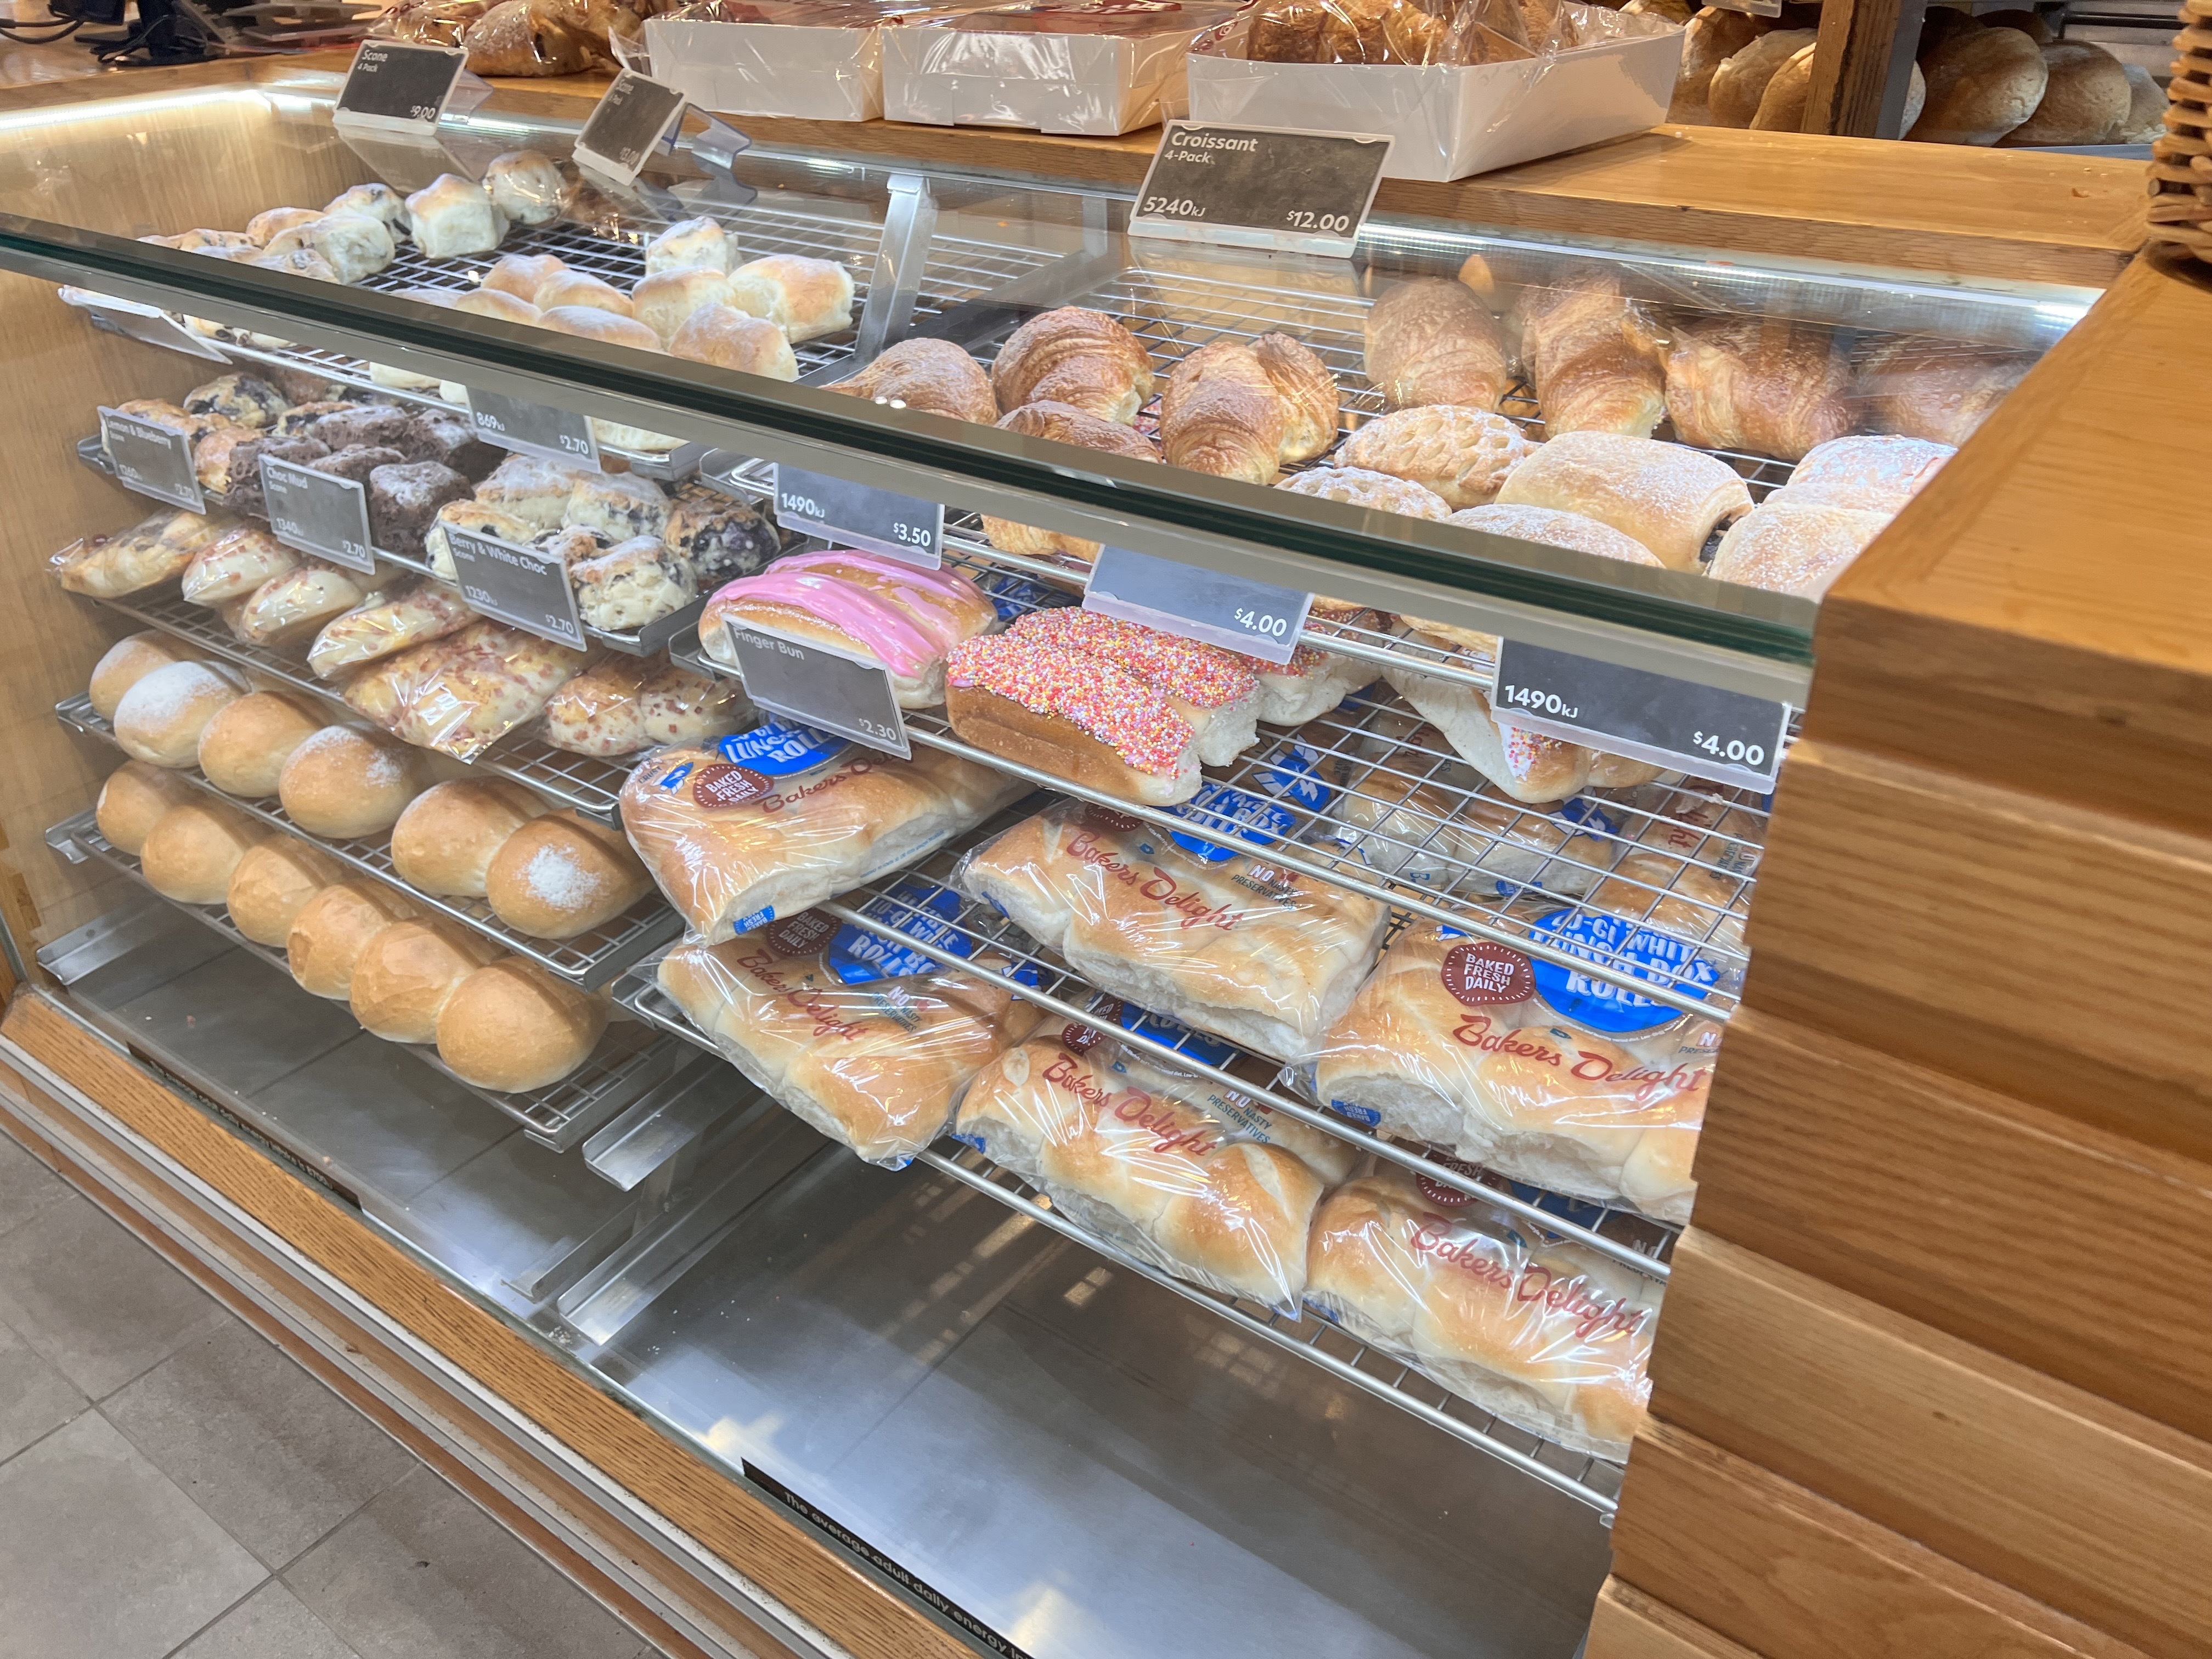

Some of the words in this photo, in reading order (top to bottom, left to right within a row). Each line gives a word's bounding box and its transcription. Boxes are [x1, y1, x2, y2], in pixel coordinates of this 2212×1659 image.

[361, 49, 388, 63] Scone
[410, 105, 436, 120] $9.00
[1171, 131, 1259, 152] Croissant
[1164, 150, 1211, 164] 4-Pack
[1143, 196, 1206, 218] 5240kJ
[1286, 210, 1350, 232] $12.00
[476, 411, 505, 432] 869kJ
[559, 434, 589, 455] $2.70
[267, 466, 288, 483] Choc
[287, 472, 308, 489] Mud
[780, 492, 826, 518] 1490kJ
[893, 522, 932, 548] $3.50
[342, 539, 366, 558] $2.70
[448, 533, 476, 555] Berry
[486, 544, 520, 567] White
[519, 555, 548, 576] Choc
[465, 585, 498, 606] 1230kJ
[545, 614, 574, 635] $2.70
[1234, 607, 1287, 637] $4.00
[733, 627, 777, 653] Finger
[777, 640, 805, 661] Bun
[1504, 684, 1579, 719] 1490kJ
[859, 718, 898, 742] $2.30
[1692, 730, 1765, 766] $4.00
[705, 770, 743, 793] BAKED
[716, 778, 753, 802] FRESH
[752, 774, 847, 813] Bakers
[728, 786, 760, 803] DAILY
[1066, 823, 1139, 885] Bakers
[1247, 864, 1276, 883] NO
[1139, 867, 1245, 931] Delight
[787, 921, 820, 941] FRESH
[797, 911, 830, 933] BAKED
[778, 929, 808, 949] DAILY
[1626, 933, 1701, 962] WHIT
[736, 948, 791, 995] Bakers
[1463, 963, 1511, 986] FRESH
[1466, 952, 1514, 976] BAKED
[887, 986, 911, 1007] NO
[1465, 975, 1506, 994] DAILY
[787, 984, 868, 1041] Delight
[1452, 1014, 1564, 1067] Bakers
[1042, 1053, 1110, 1107] Bakers
[1571, 1050, 1708, 1101] Delight
[1223, 1090, 1251, 1109] NO
[1114, 1086, 1217, 1156] Delight
[1207, 1094, 1271, 1144] PRESERVATIVES
[1243, 1107, 1273, 1130] NASTY
[1411, 1212, 1513, 1289] Bakers
[1517, 1265, 1645, 1338] Delight
[783, 1491, 809, 1516] The
[811, 1511, 870, 1558] average
[873, 1554, 911, 1585] adult
[913, 1579, 950, 1614] daily
[952, 1610, 1009, 1654] energy
